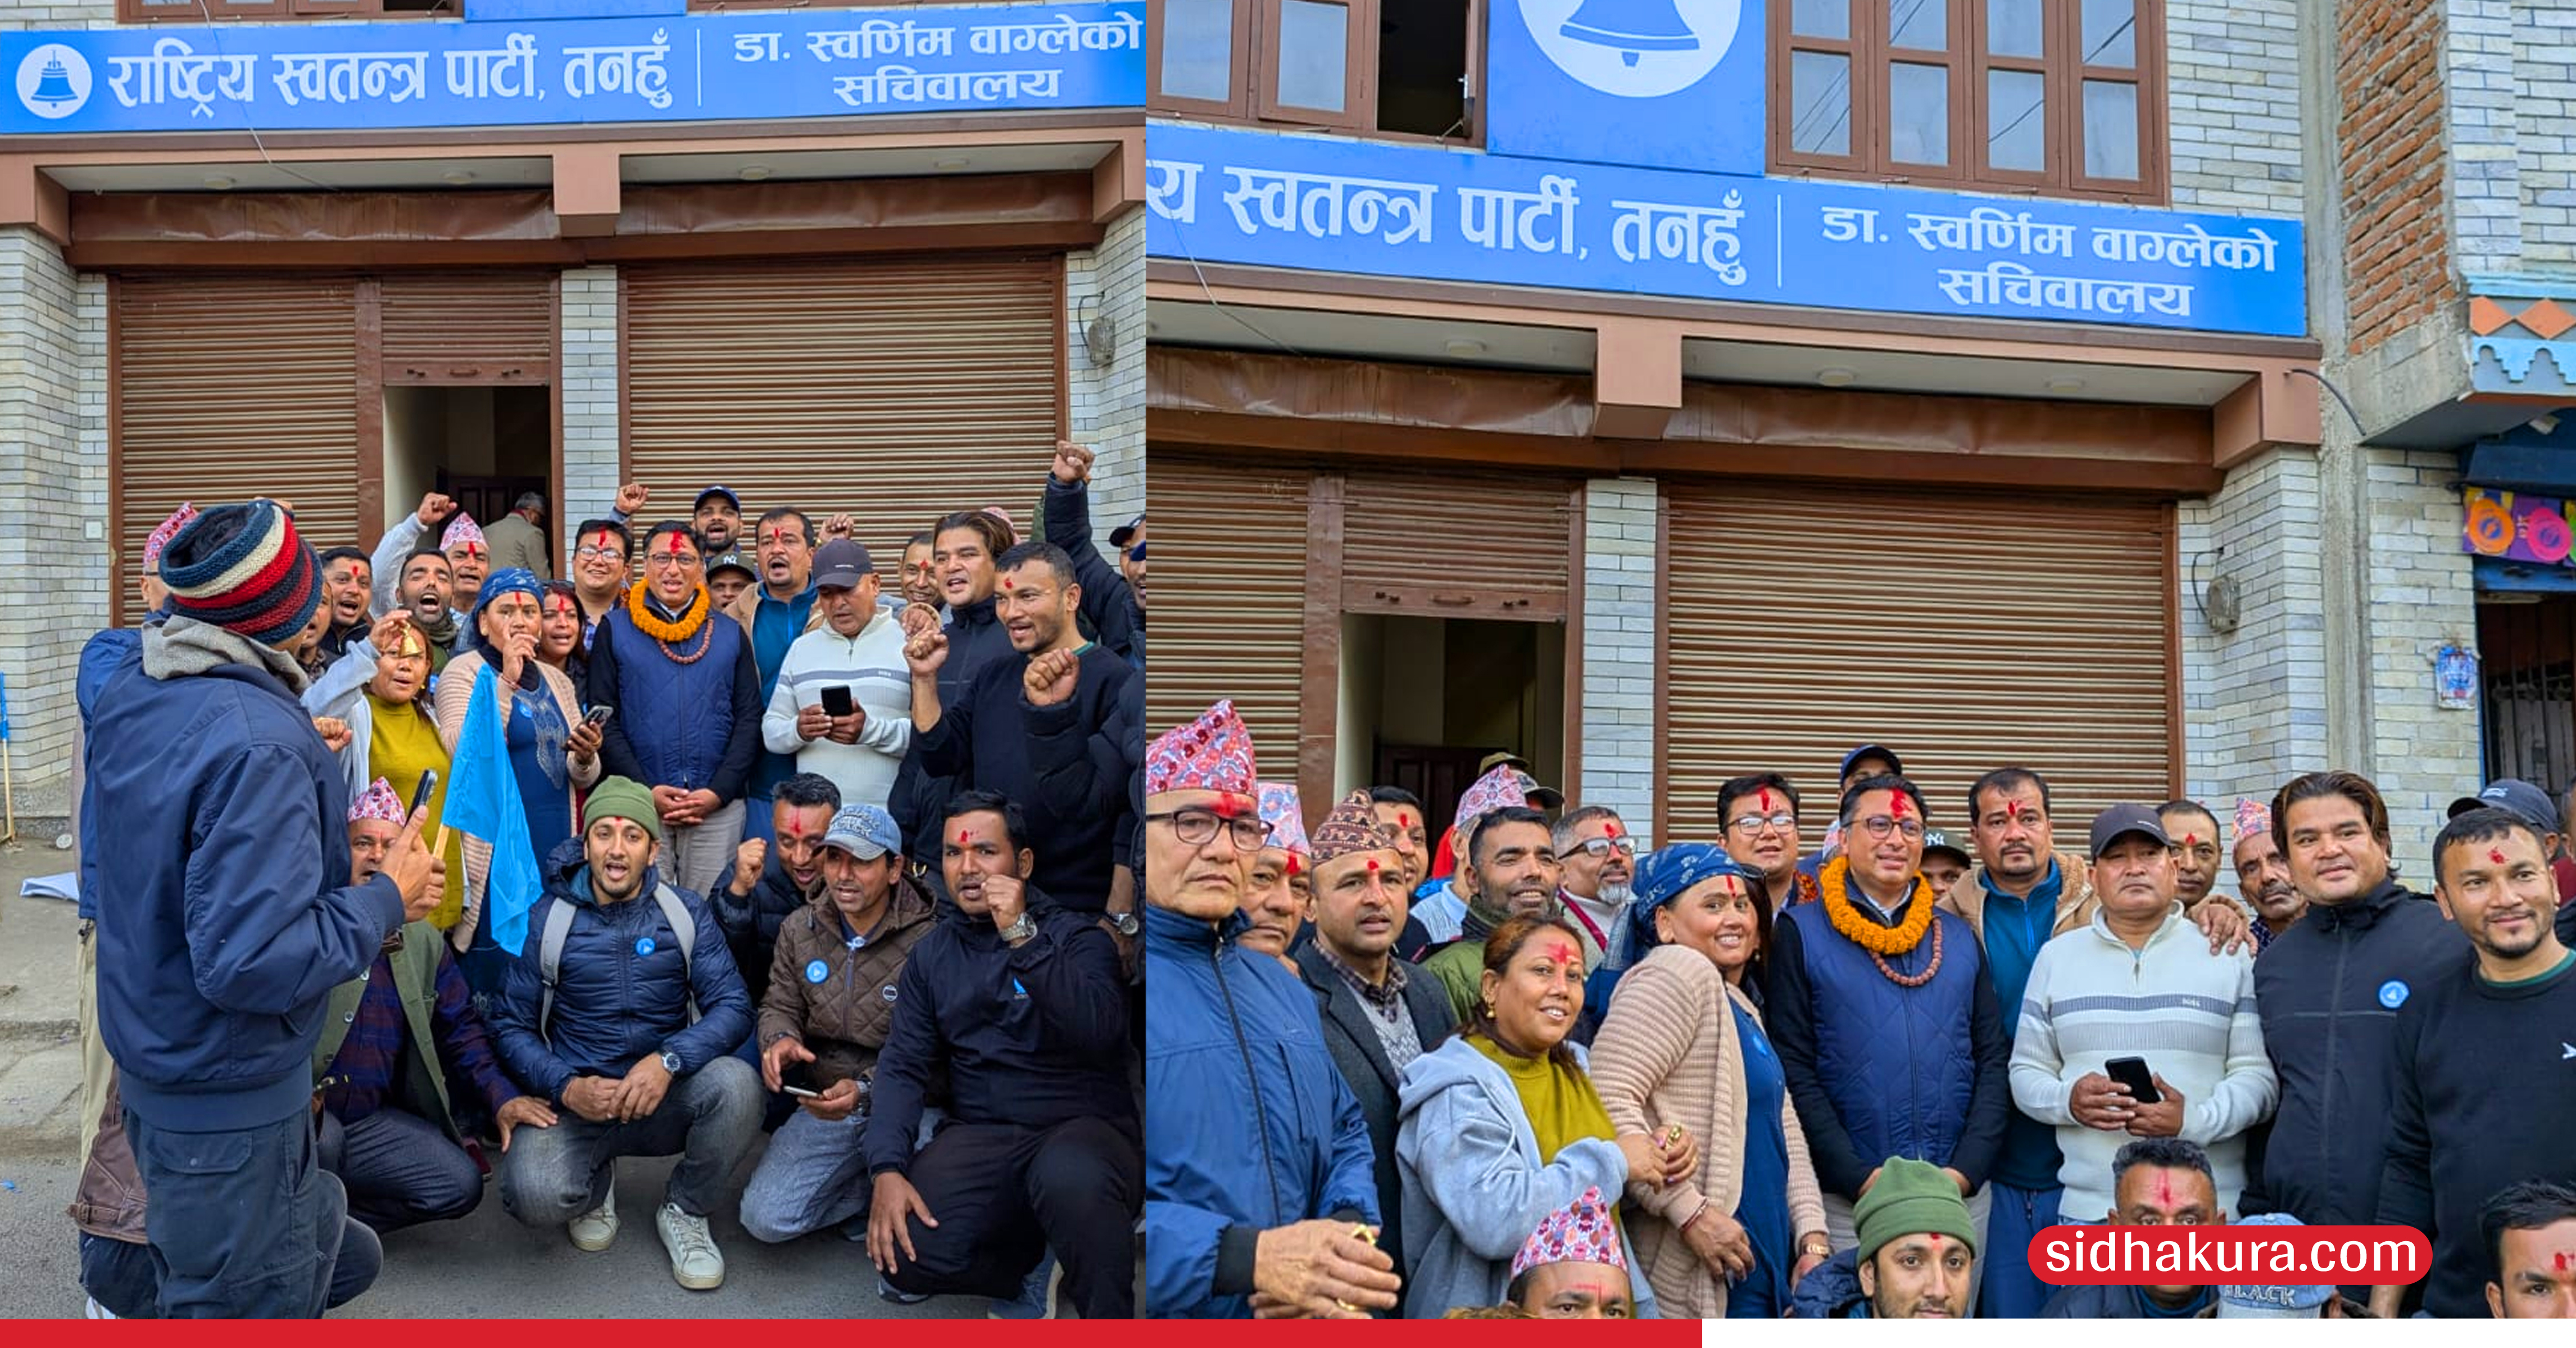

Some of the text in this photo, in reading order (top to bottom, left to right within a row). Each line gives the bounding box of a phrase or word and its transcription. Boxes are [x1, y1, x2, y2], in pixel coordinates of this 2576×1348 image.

[734, 11, 1144, 62] डा. स्वर्णिम वाग्लेको
[108, 37, 258, 117] राष्ट्रिय
[272, 51, 429, 106] स्वतन्त्र
[443, 33, 545, 100] पार्टी,
[833, 65, 1062, 106] सचिवालय
[1223, 165, 1438, 245] स्वतन्त्र
[1458, 174, 1588, 260] पार्टी,
[1822, 206, 2278, 272] डा. स्वर्णिम वाग्लेको
[1938, 261, 2194, 316] सचिवालय
